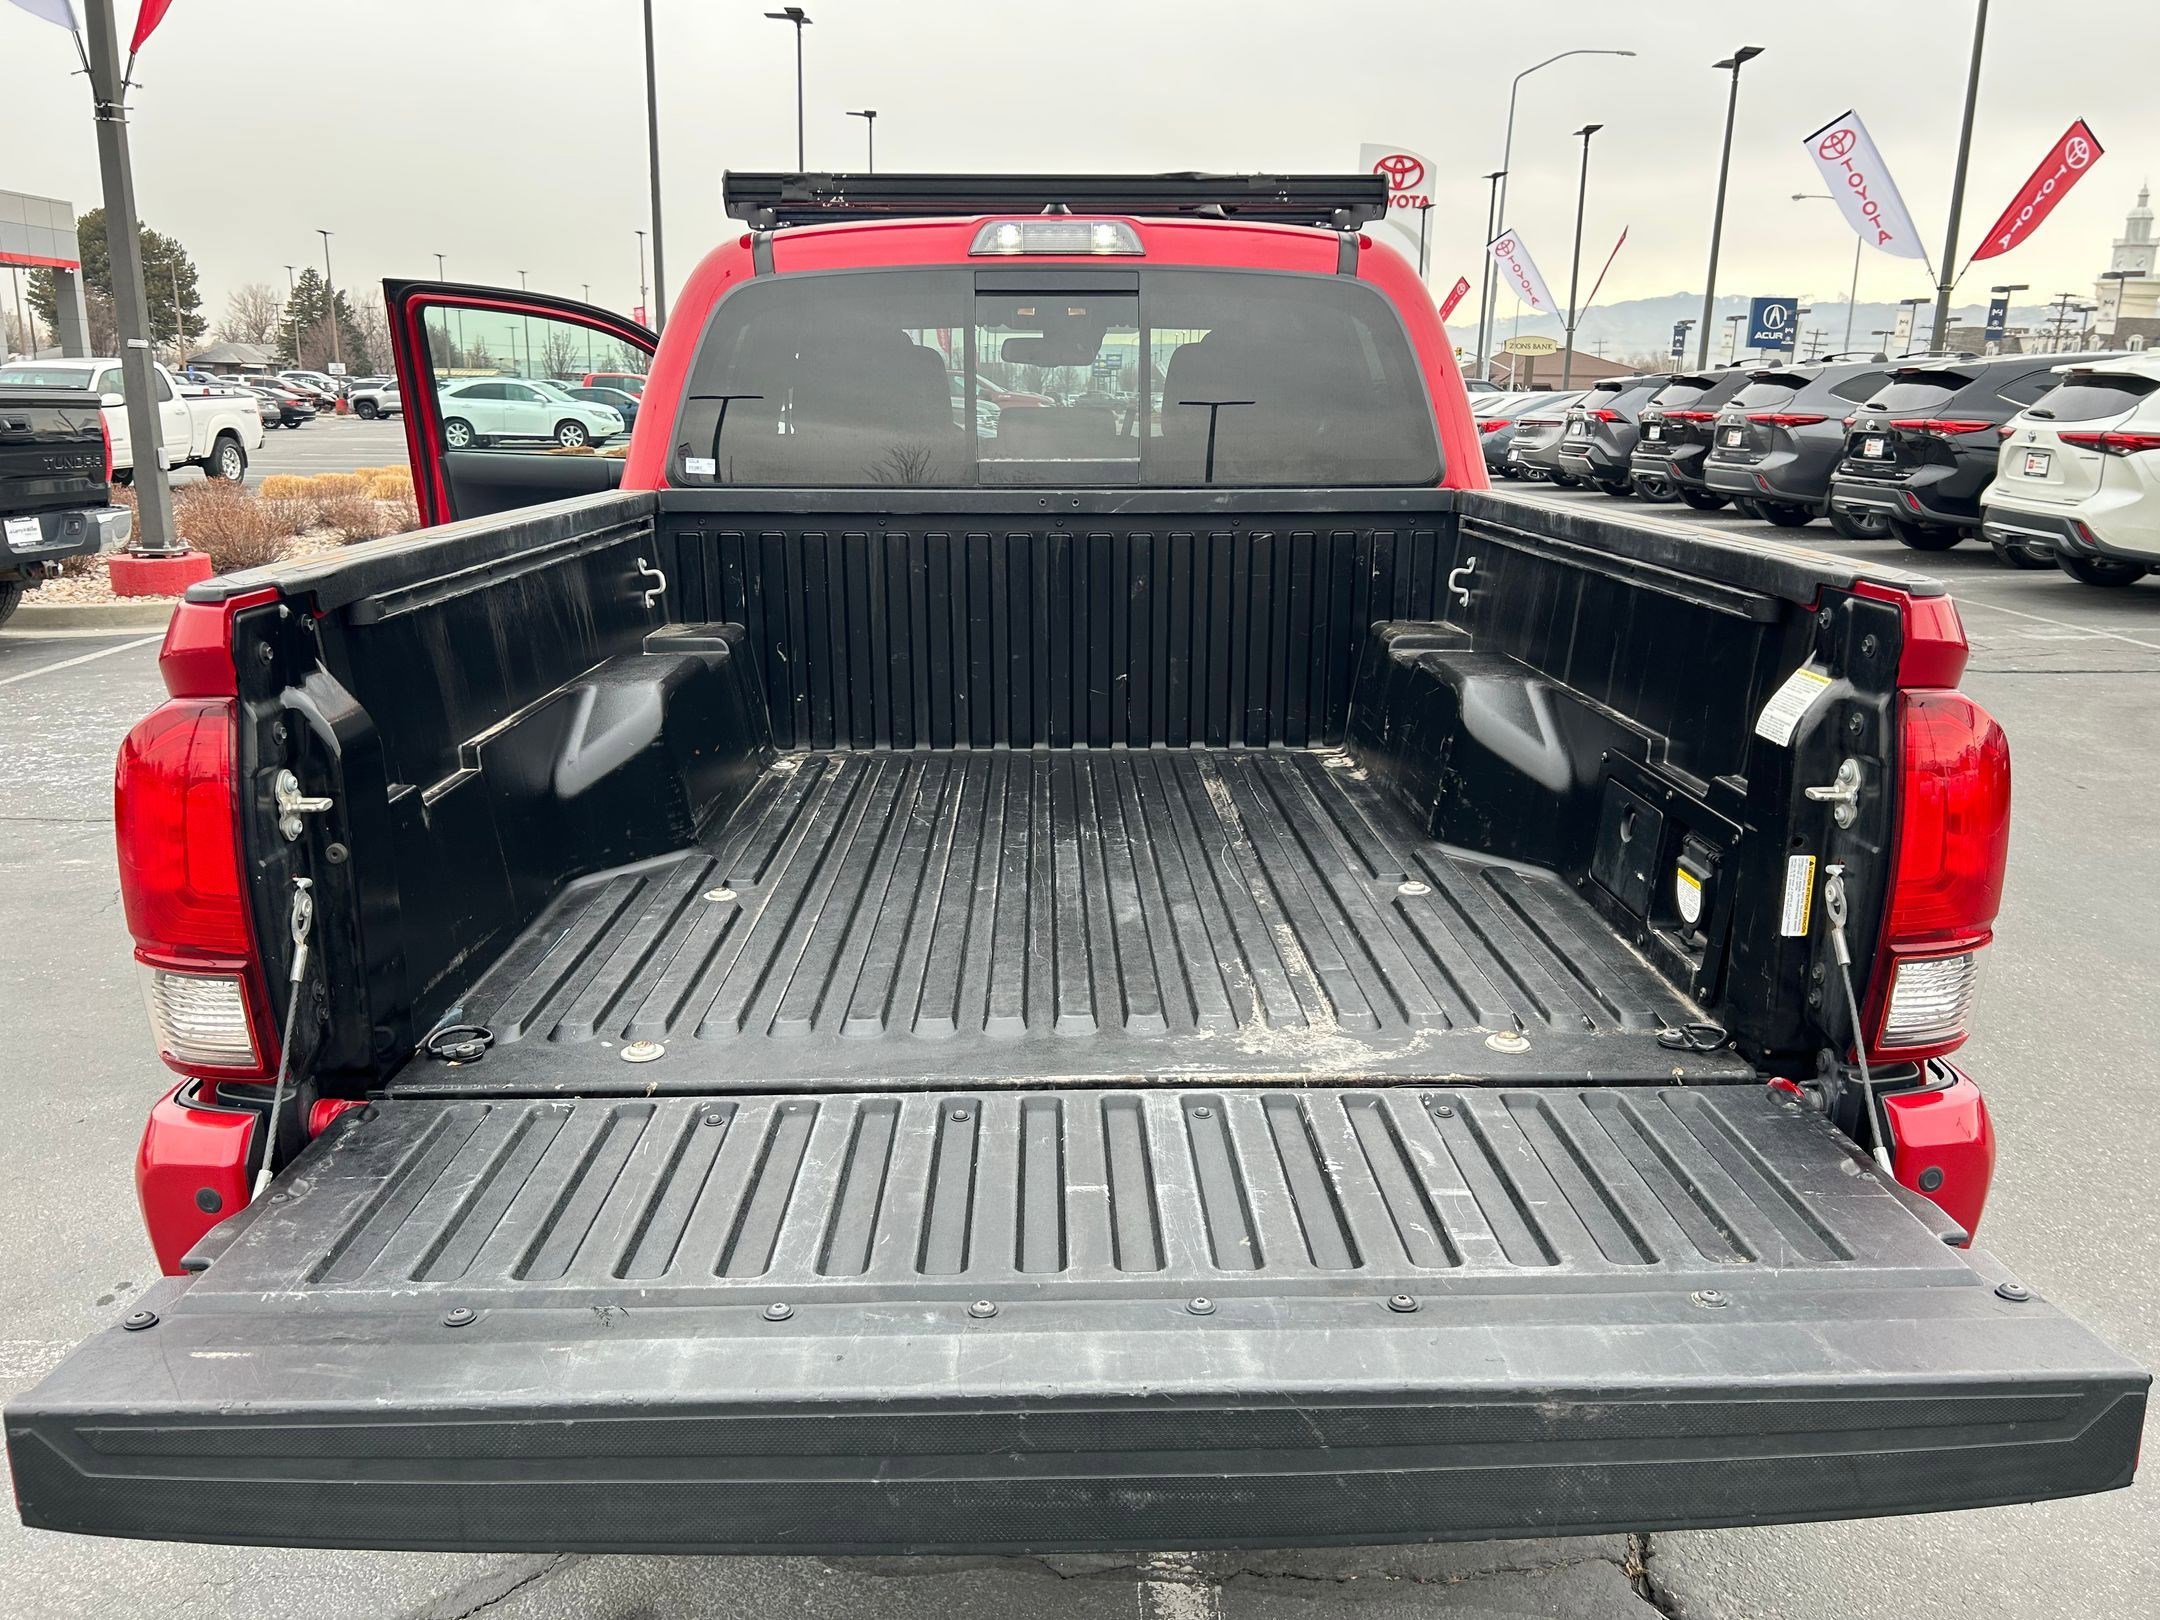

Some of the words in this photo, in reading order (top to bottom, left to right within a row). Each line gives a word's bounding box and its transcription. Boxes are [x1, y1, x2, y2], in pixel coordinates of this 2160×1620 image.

[1388, 194, 1430, 208] YOTA
[1841, 158, 1893, 245] TOYOTA
[1998, 164, 2067, 249] TOYOTA
[1508, 255, 1540, 305] TOYOTA
[1754, 331, 1784, 340] ACUR
[42, 456, 103, 470] TUNDRA
[1804, 887, 1812, 911] ATTENTION
